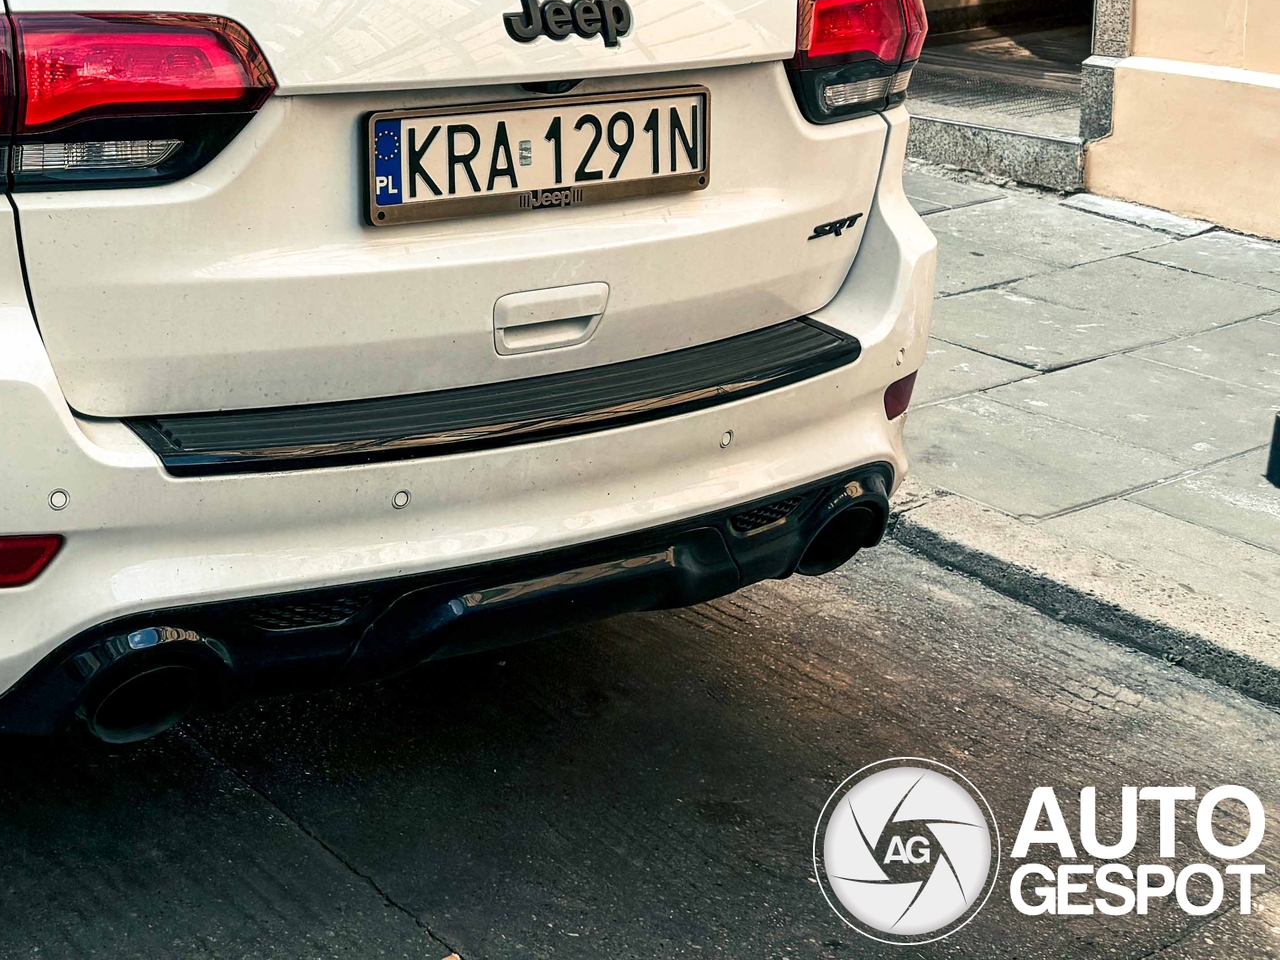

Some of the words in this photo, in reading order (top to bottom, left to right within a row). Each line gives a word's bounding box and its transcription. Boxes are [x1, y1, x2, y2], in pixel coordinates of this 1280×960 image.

[408, 120, 518, 199] KRA
[544, 105, 698, 184] 1291N
[376, 176, 399, 196] PL
[531, 187, 572, 208] Jeep
[807, 212, 863, 241] SRT
